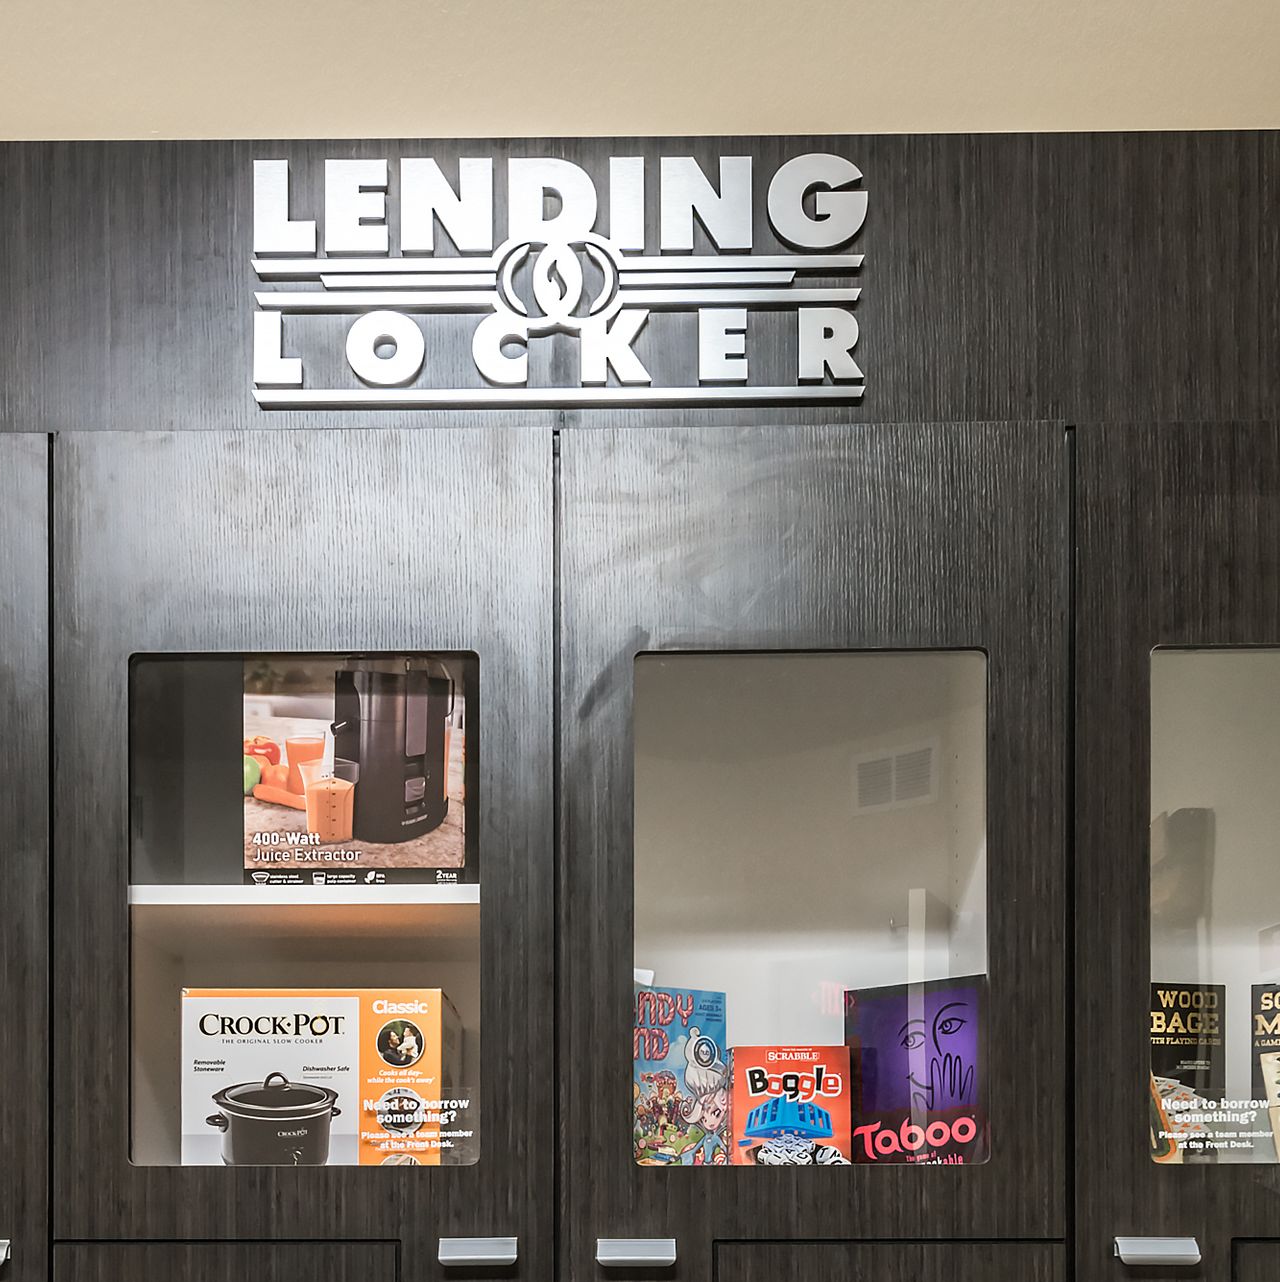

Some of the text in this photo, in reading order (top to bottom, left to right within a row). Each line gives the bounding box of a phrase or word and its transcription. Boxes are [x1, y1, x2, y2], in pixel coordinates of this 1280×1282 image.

[253, 153, 869, 254] LENDING
[253, 307, 866, 387] LOCKER
[252, 832, 321, 846] 400-Watt
[252, 849, 362, 862] Juice Extractor
[1157, 990, 1218, 1009] WOOD
[372, 1000, 428, 1015] Classic
[634, 991, 694, 1028] NDY
[1150, 1011, 1219, 1034] BAGE
[1150, 1037, 1165, 1045] ITH
[767, 1051, 820, 1061] SCRABBLE
[746, 1065, 842, 1102] Boggle
[363, 1098, 469, 1111] Need to borrow
[1161, 1098, 1270, 1110] Need to borrow
[376, 1110, 457, 1124] something?
[1174, 1110, 1258, 1124] something?
[853, 1117, 977, 1160] Taboo
